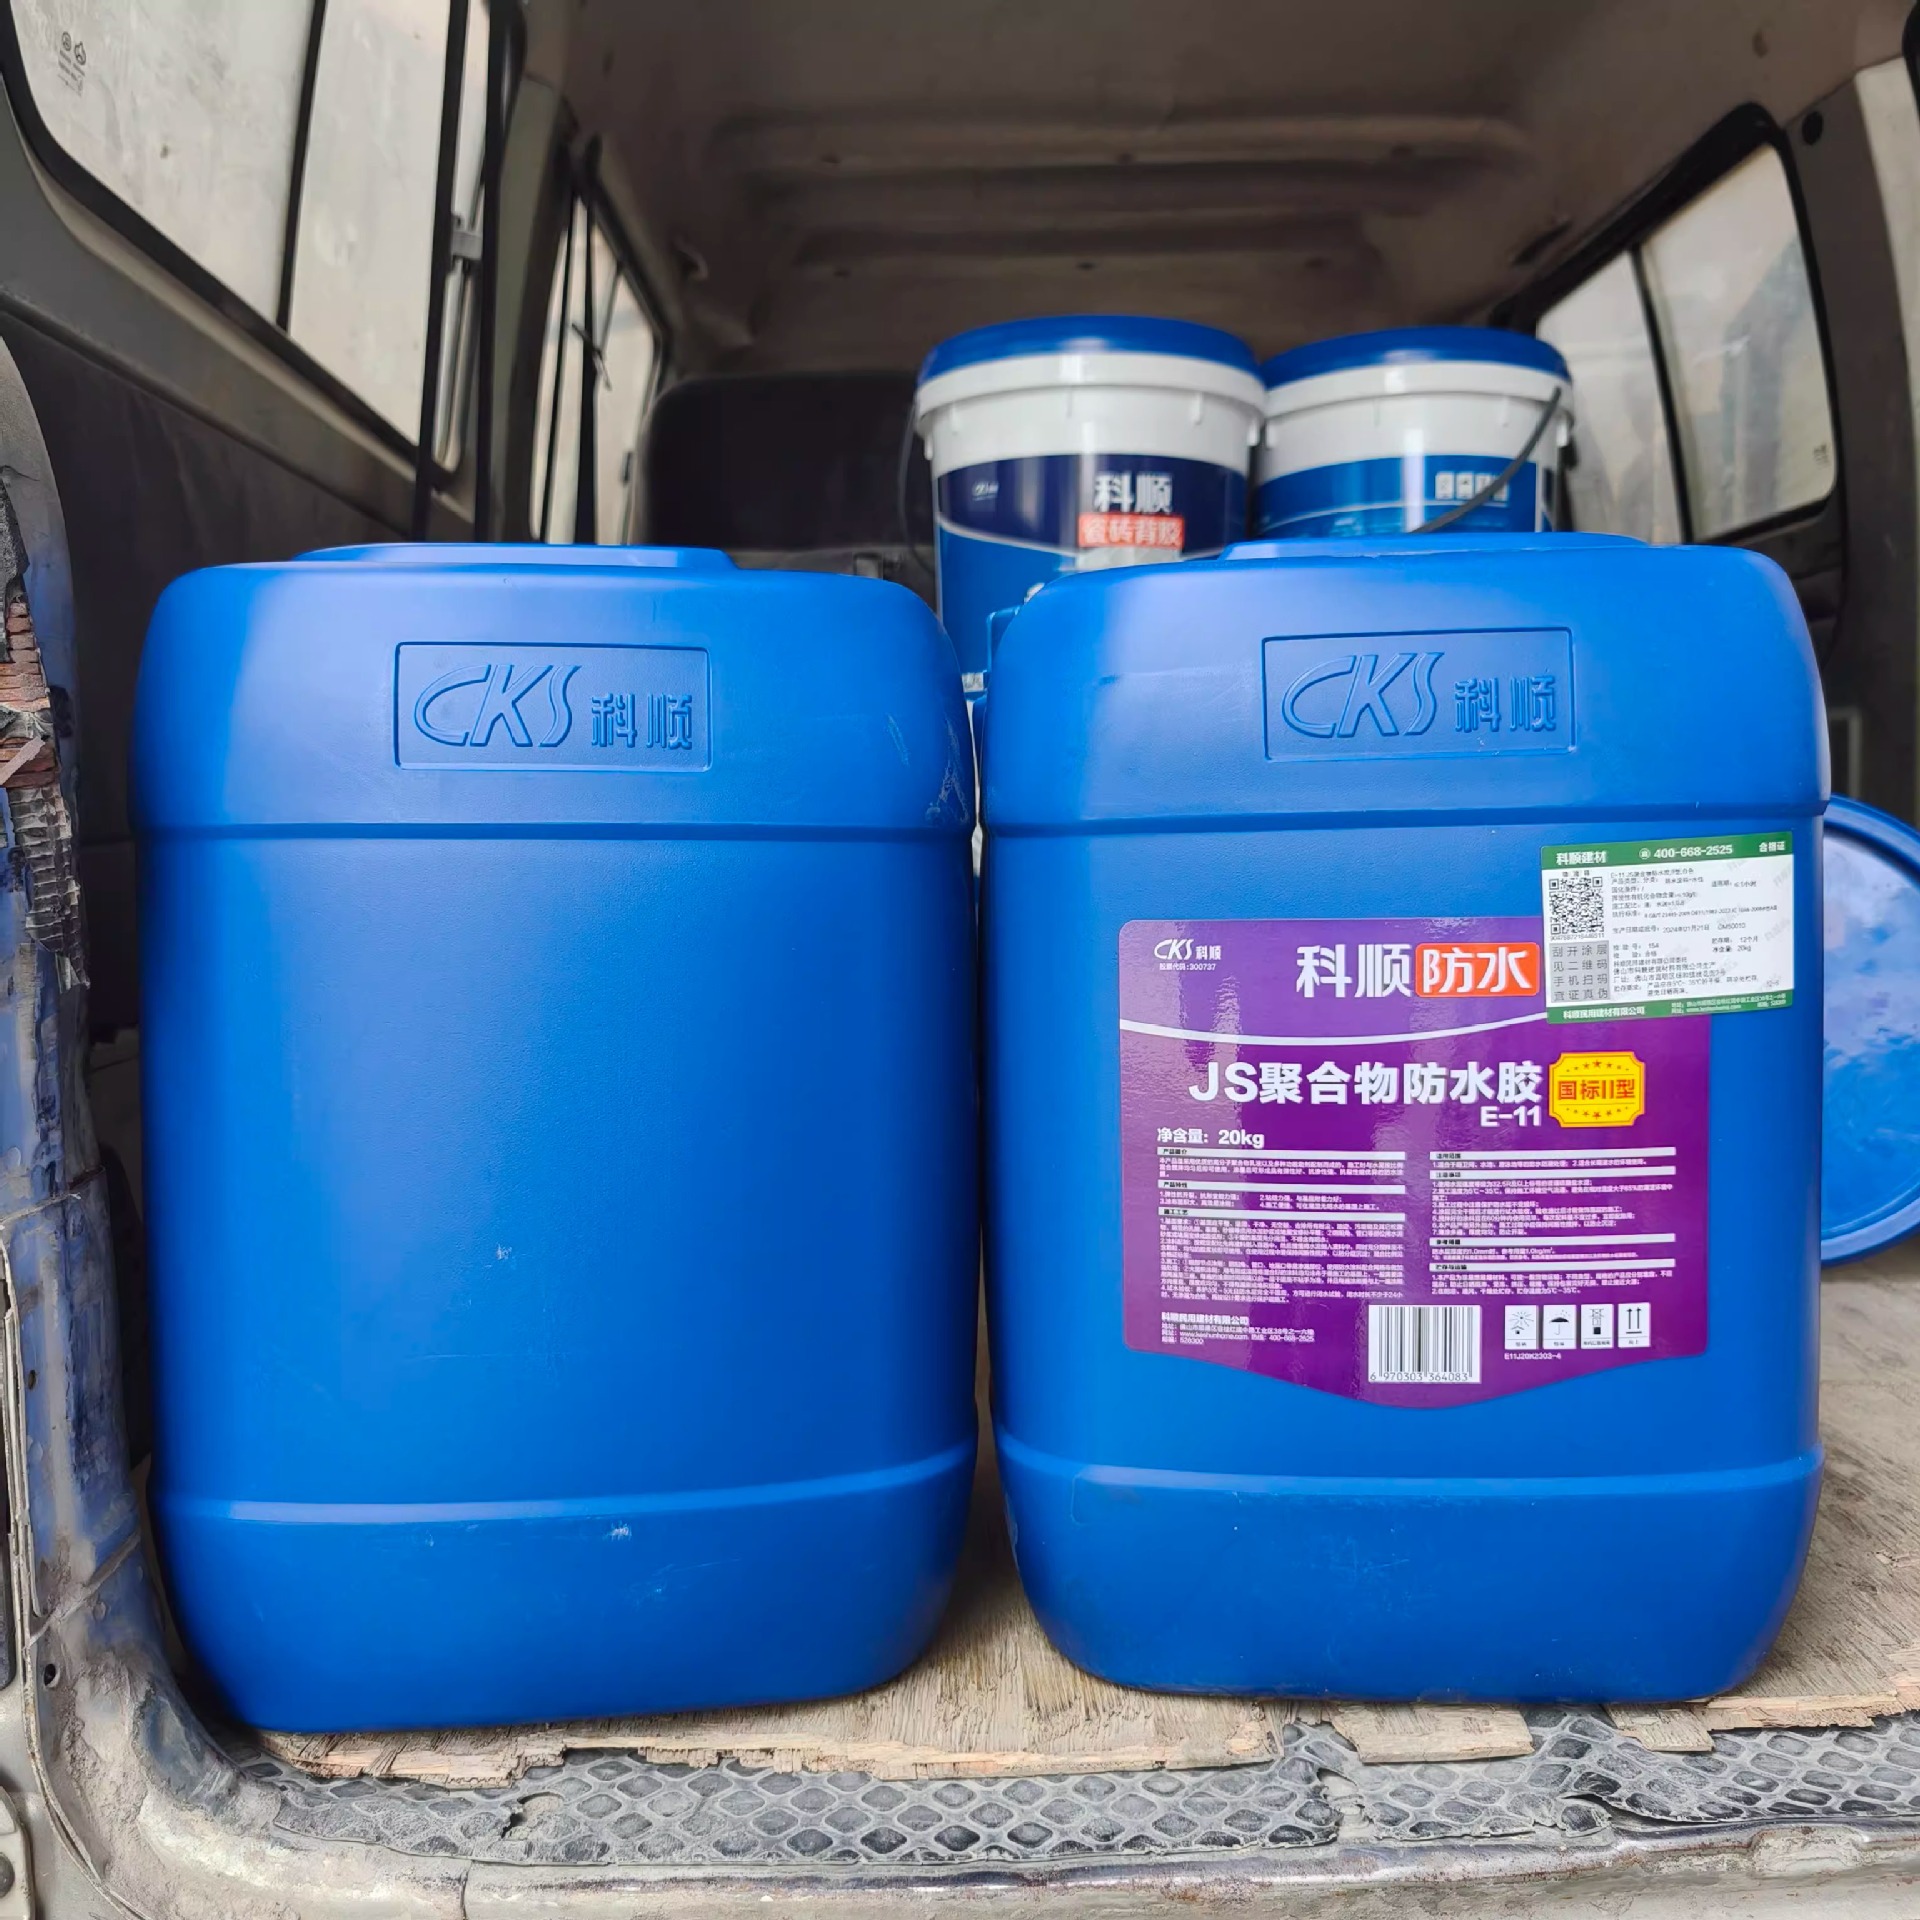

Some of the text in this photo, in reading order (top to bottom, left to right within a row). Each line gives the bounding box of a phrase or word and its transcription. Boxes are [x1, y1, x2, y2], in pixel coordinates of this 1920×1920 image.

[1094, 472, 1173, 513] 科顺
[1282, 652, 1556, 738] CKS 科顺
[414, 664, 693, 749] CKS 科顺
[1556, 841, 1786, 866] 科顺建材 400-668-2525 合格证
[1154, 939, 1222, 961] CKS 科顺
[1552, 944, 1608, 958] 刮开涂层
[1296, 943, 1533, 999] 科顺 防水
[1553, 959, 1608, 972] 见二维码
[1553, 973, 1608, 987] 手机扫码
[1554, 988, 1609, 1001] 查证真伪
[1188, 1060, 1543, 1106] JS聚合物防水胶
[1480, 1105, 1542, 1127] E-11
[1217, 1129, 1265, 1148] 20kg
[1161, 1311, 1250, 1326] 科顺民用建材有限公司
[1370, 1372, 1468, 1382] 6 970303 364083
